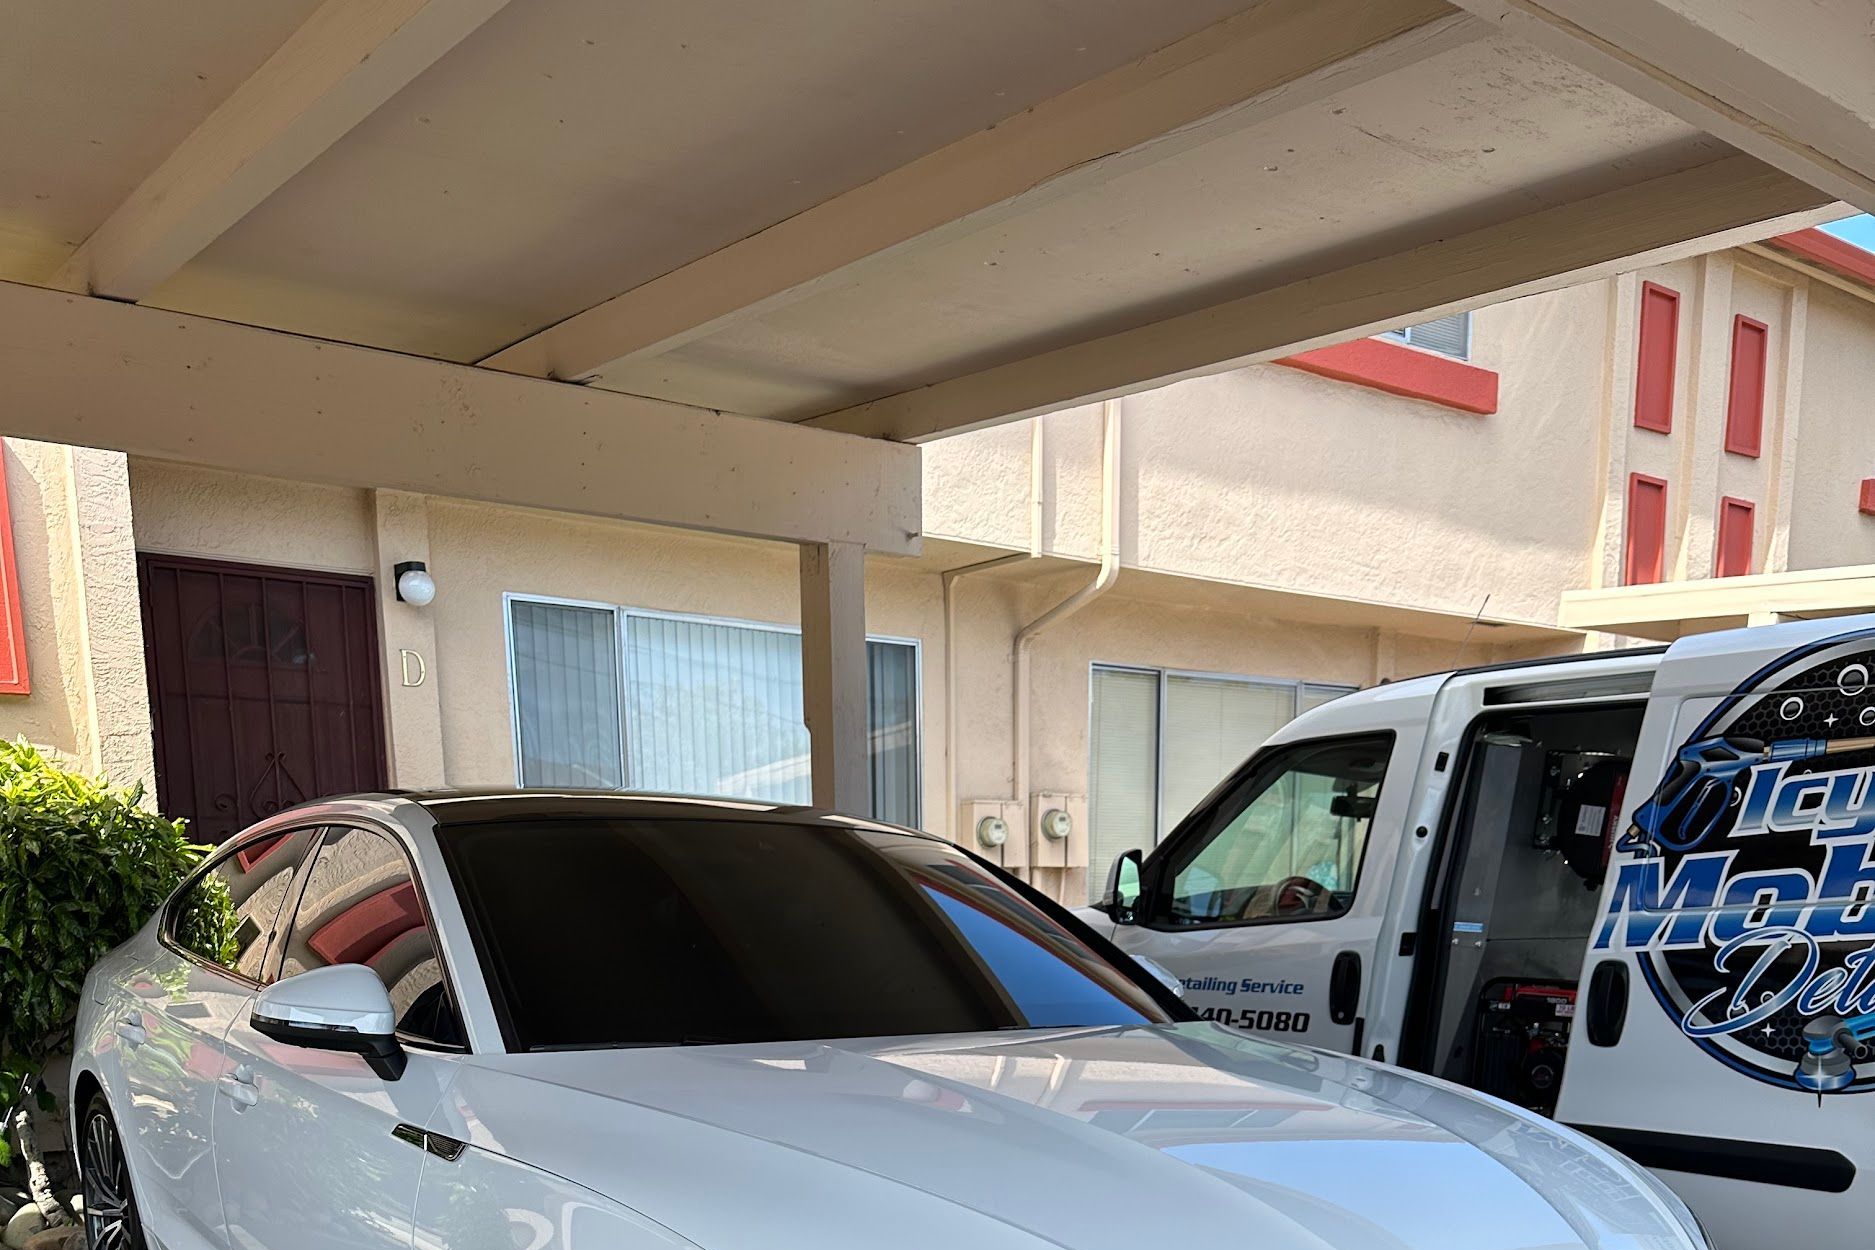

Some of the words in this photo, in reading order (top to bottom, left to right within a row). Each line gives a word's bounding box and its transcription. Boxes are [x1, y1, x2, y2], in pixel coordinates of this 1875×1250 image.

[400, 649, 426, 687] D
[1727, 761, 1875, 846] Icy
[1179, 976, 1237, 995] etailing
[1240, 978, 1304, 995] Service
[1681, 926, 1875, 1037] Det
[1192, 1007, 1310, 1033] 40-5080
